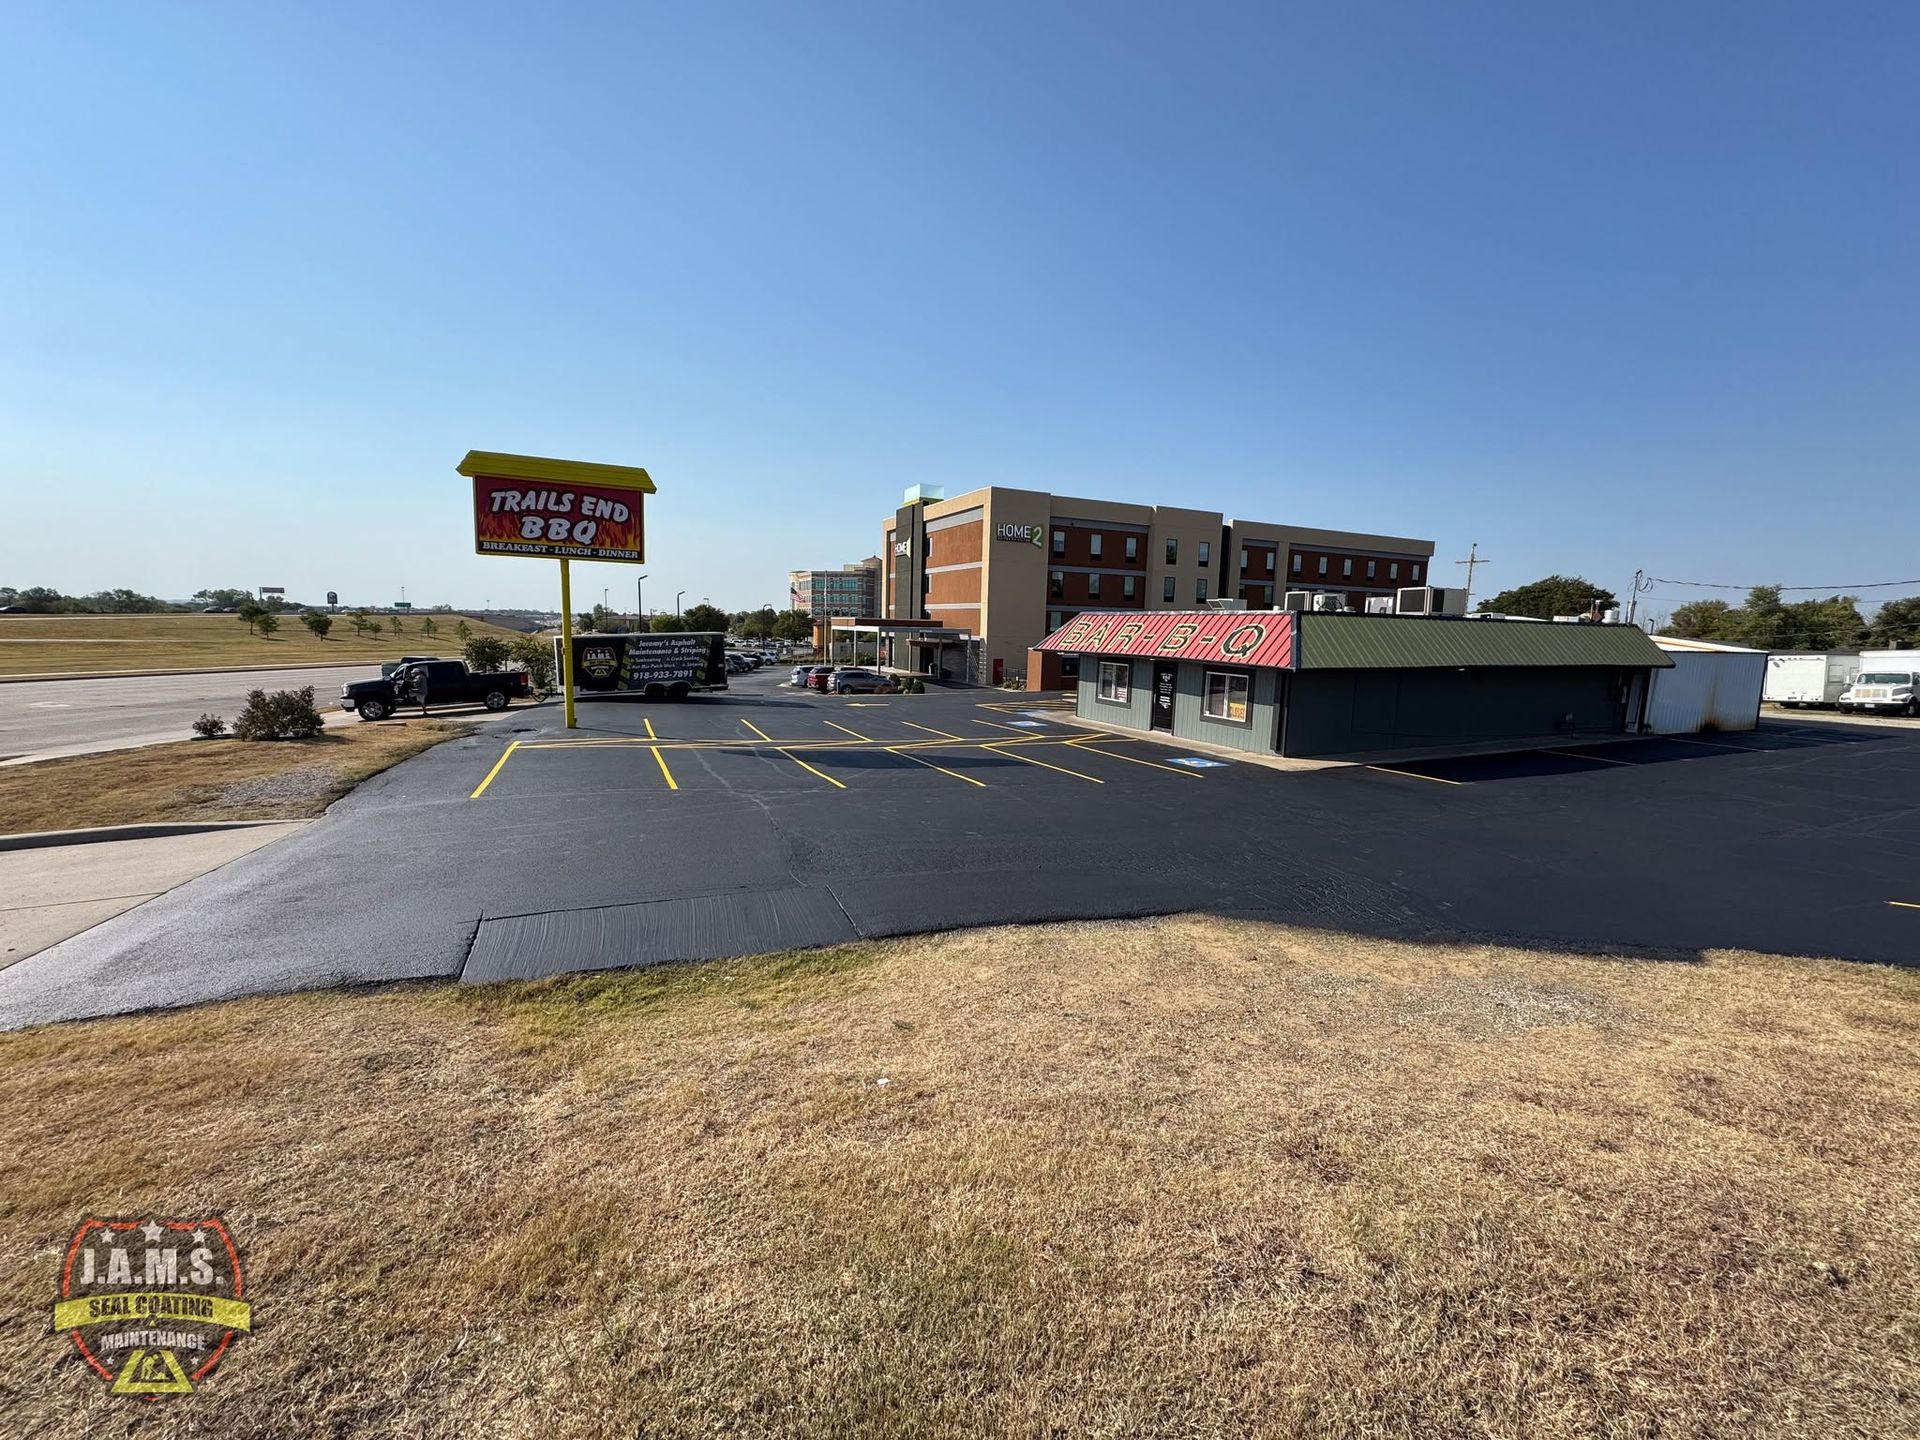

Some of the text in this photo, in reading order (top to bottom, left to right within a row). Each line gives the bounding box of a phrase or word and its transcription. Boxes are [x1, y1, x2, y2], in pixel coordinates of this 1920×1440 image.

[490, 490, 629, 523] TRAILS END
[520, 516, 597, 545] BBQ
[483, 541, 549, 554] BREAKFAST
[554, 546, 592, 556] LUNCH
[598, 549, 638, 559] DINNER
[633, 670, 693, 679] 918-933-7891
